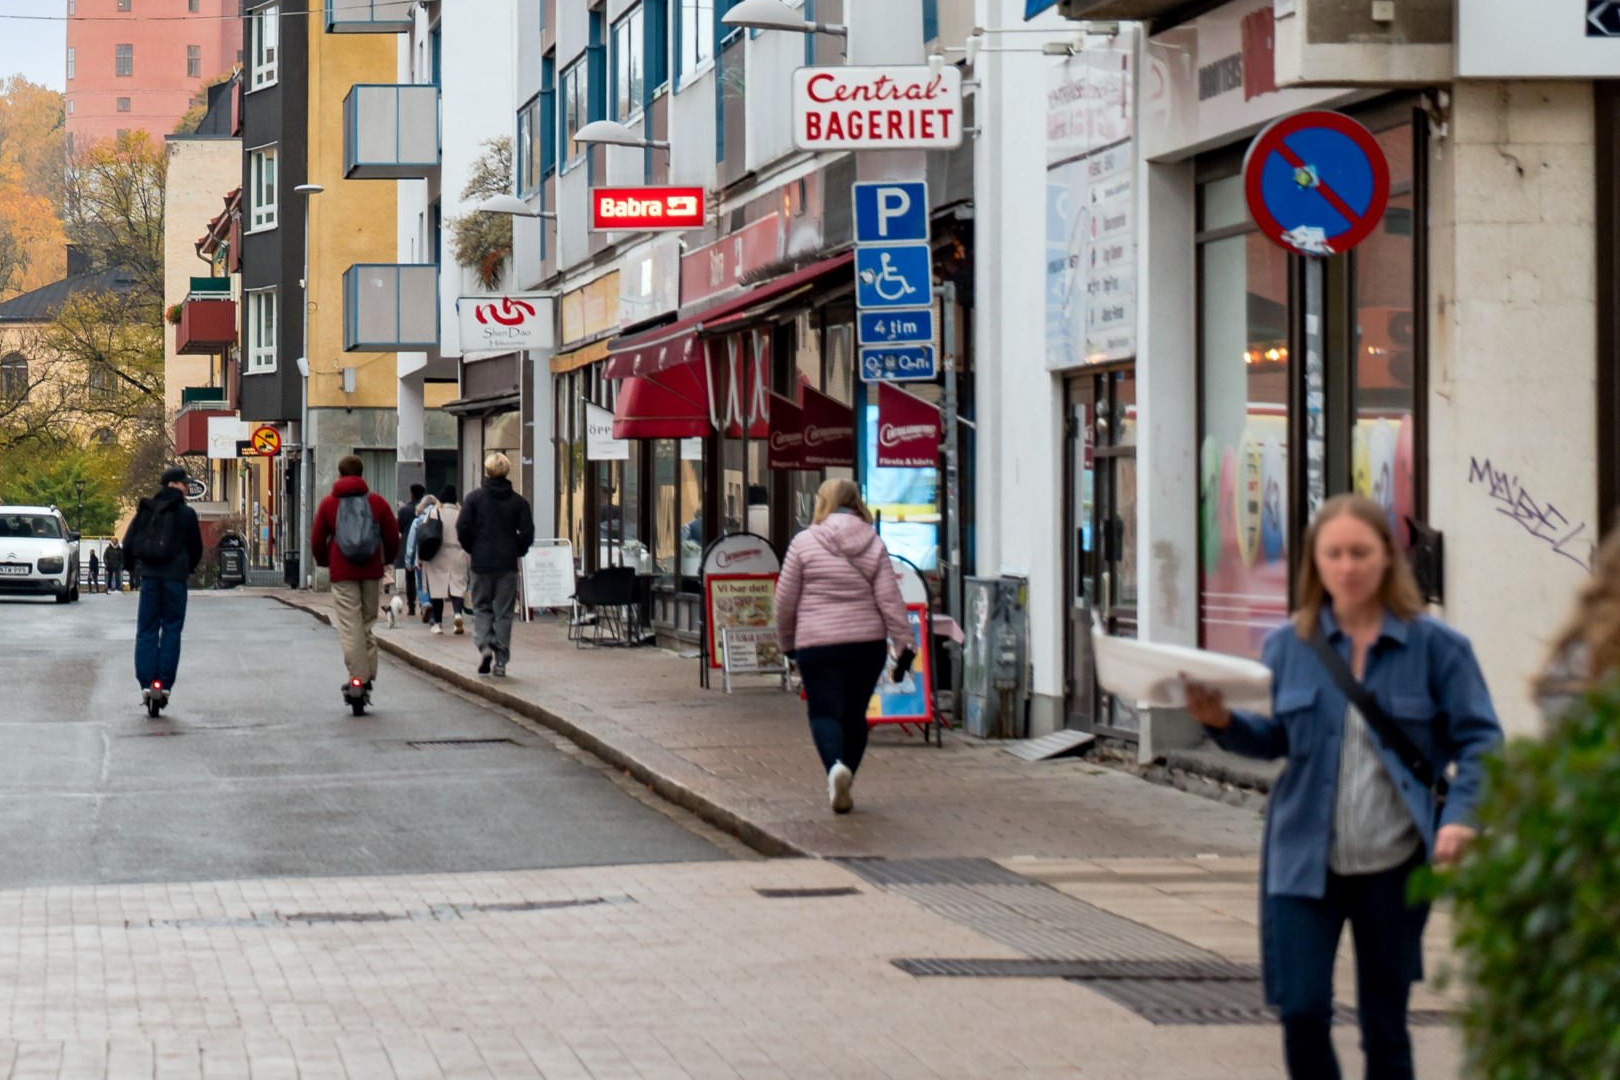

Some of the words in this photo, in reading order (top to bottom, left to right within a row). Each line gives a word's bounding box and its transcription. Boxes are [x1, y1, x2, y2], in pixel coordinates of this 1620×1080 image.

[806, 109, 953, 140] BAGERIET
[600, 197, 662, 217] Babra
[876, 187, 910, 236] P
[874, 320, 886, 334] 4
[890, 318, 917, 334] tim
[589, 424, 612, 435] ÖPP
[717, 584, 728, 592] Vi
[730, 584, 747, 593] har
